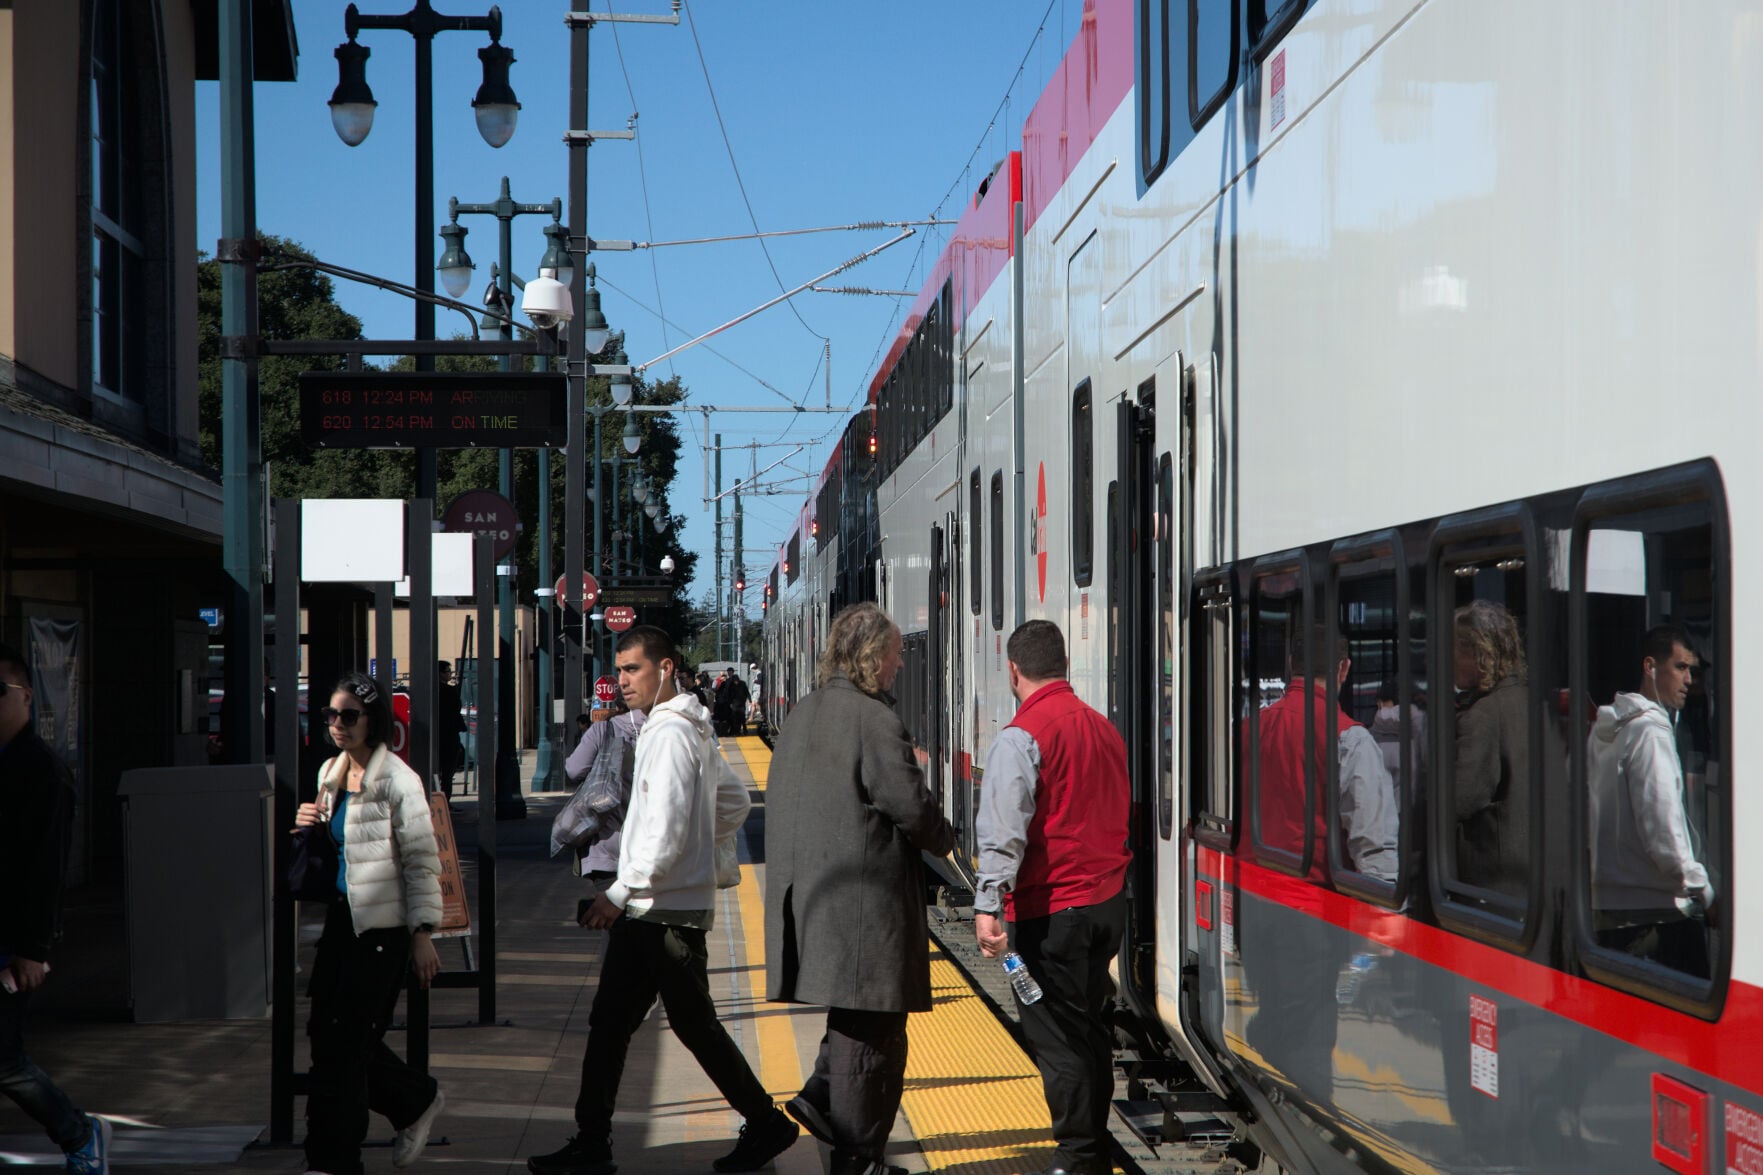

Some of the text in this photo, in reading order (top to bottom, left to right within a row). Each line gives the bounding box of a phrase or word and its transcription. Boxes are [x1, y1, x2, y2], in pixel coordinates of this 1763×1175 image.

[322, 390, 350, 405] 618
[409, 390, 433, 405] PM
[322, 416, 350, 430] 620
[409, 416, 433, 430] PM
[451, 416, 475, 430] ON
[480, 416, 518, 430] TIME
[464, 512, 497, 523] SAN
[596, 683, 619, 695] STOP
